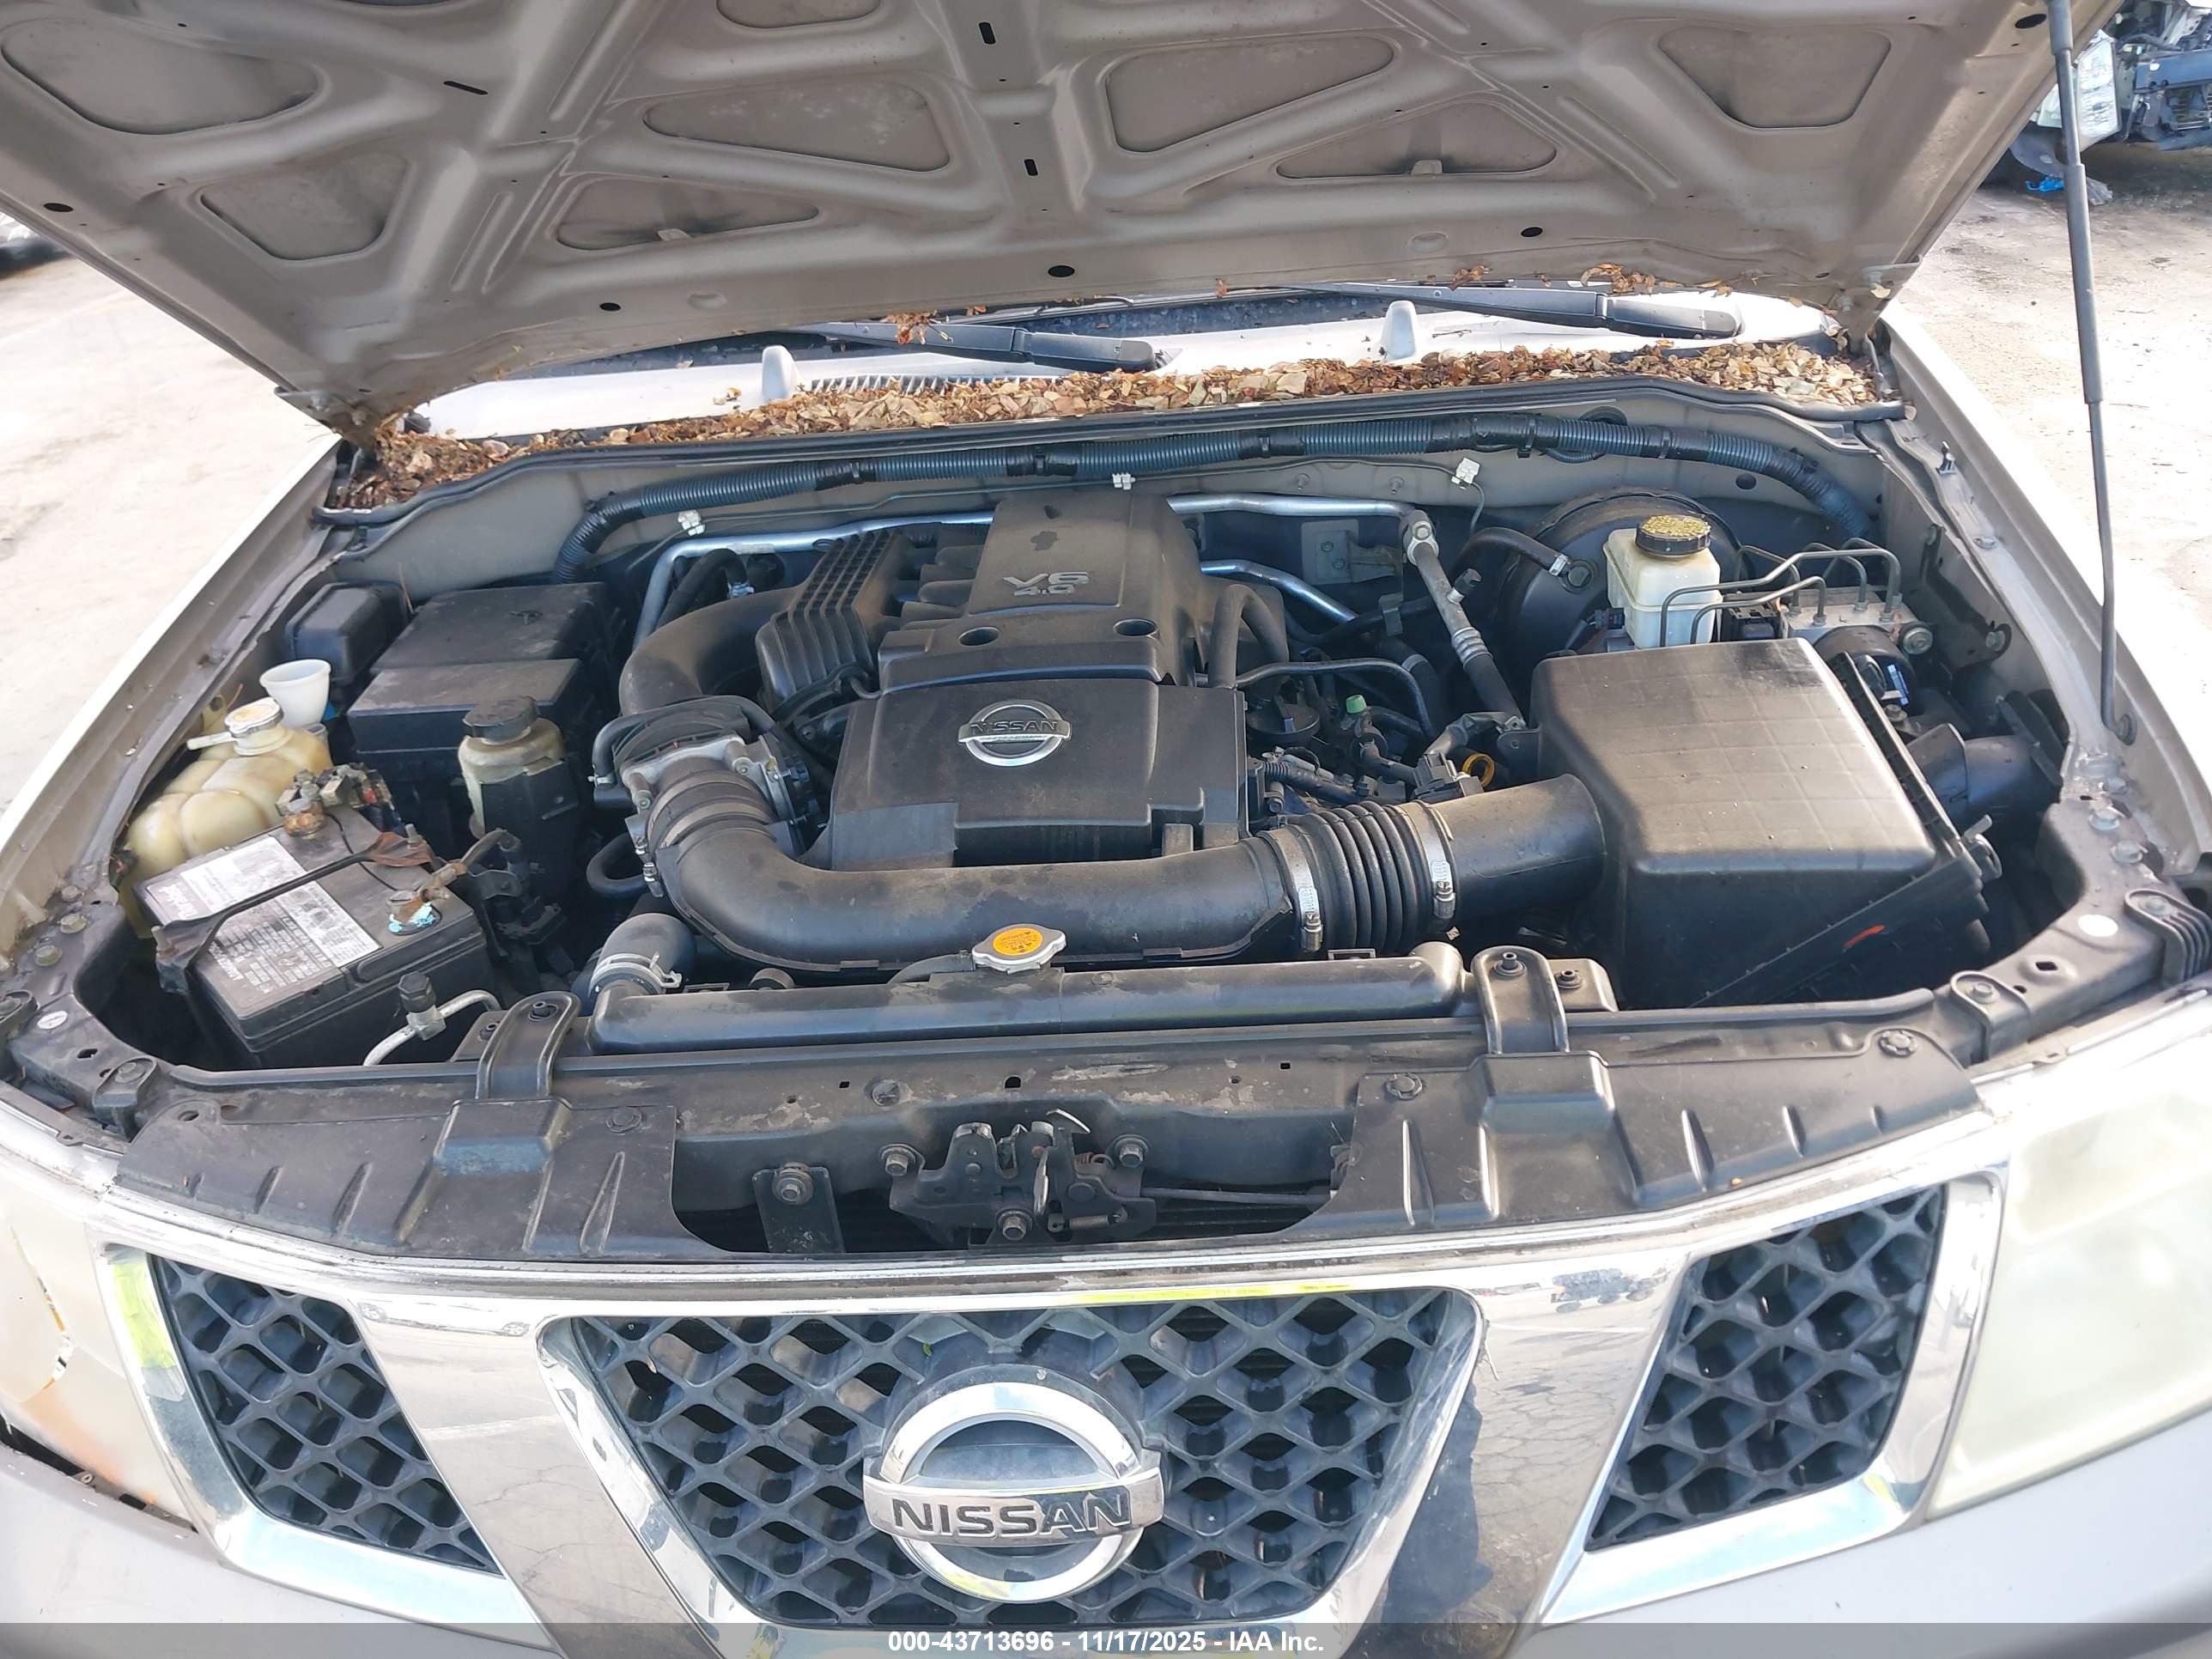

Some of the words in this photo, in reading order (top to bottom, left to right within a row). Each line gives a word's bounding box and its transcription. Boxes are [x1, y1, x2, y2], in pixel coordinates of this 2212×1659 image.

[1002, 571, 1090, 588] V6
[969, 720, 1059, 734] NISSAN
[891, 1492, 1132, 1537] NISSAN
